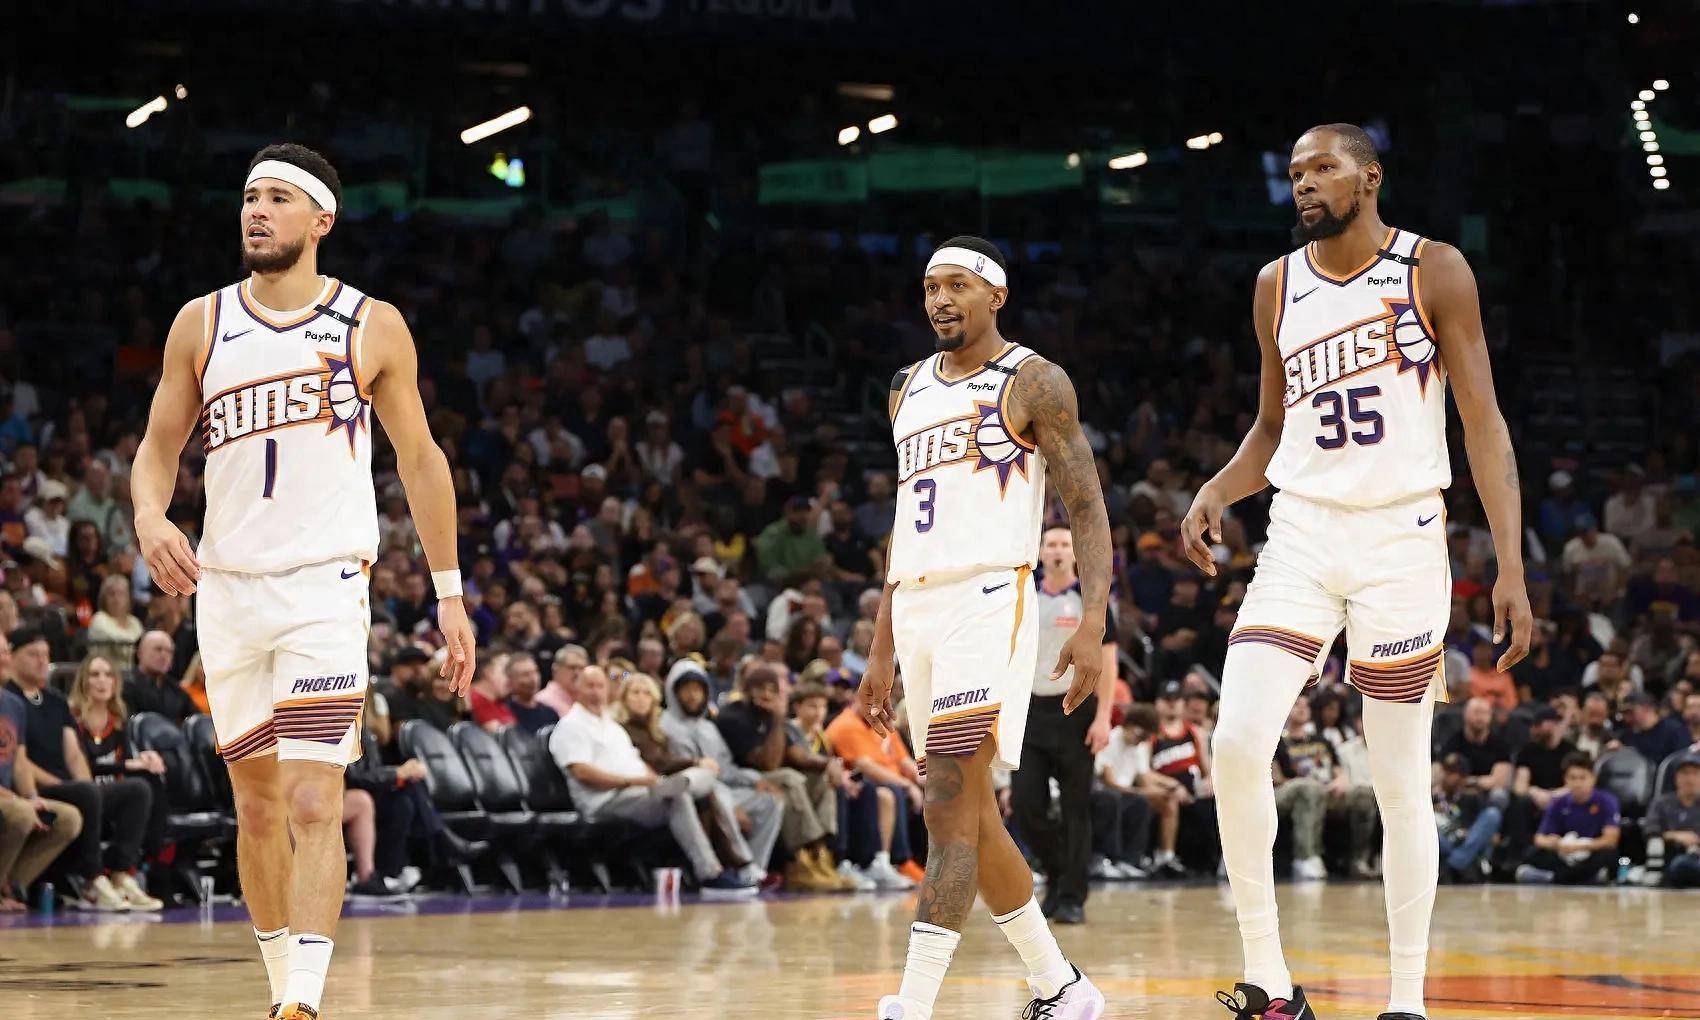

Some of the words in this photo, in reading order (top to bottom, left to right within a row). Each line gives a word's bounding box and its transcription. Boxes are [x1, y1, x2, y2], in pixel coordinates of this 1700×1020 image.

[1367, 276, 1402, 287] PayPal
[304, 330, 341, 343] PayPal
[1284, 320, 1388, 407] SUNS
[966, 382, 997, 392] PayPal
[209, 374, 322, 448] SUNS
[1312, 385, 1384, 450] 35
[262, 438, 279, 499] 1
[898, 421, 972, 482] UNS
[913, 478, 937, 534] 3
[1370, 629, 1433, 658] PHOENIX
[291, 673, 357, 694] PHOENIX
[931, 687, 990, 714] PHOENIX
